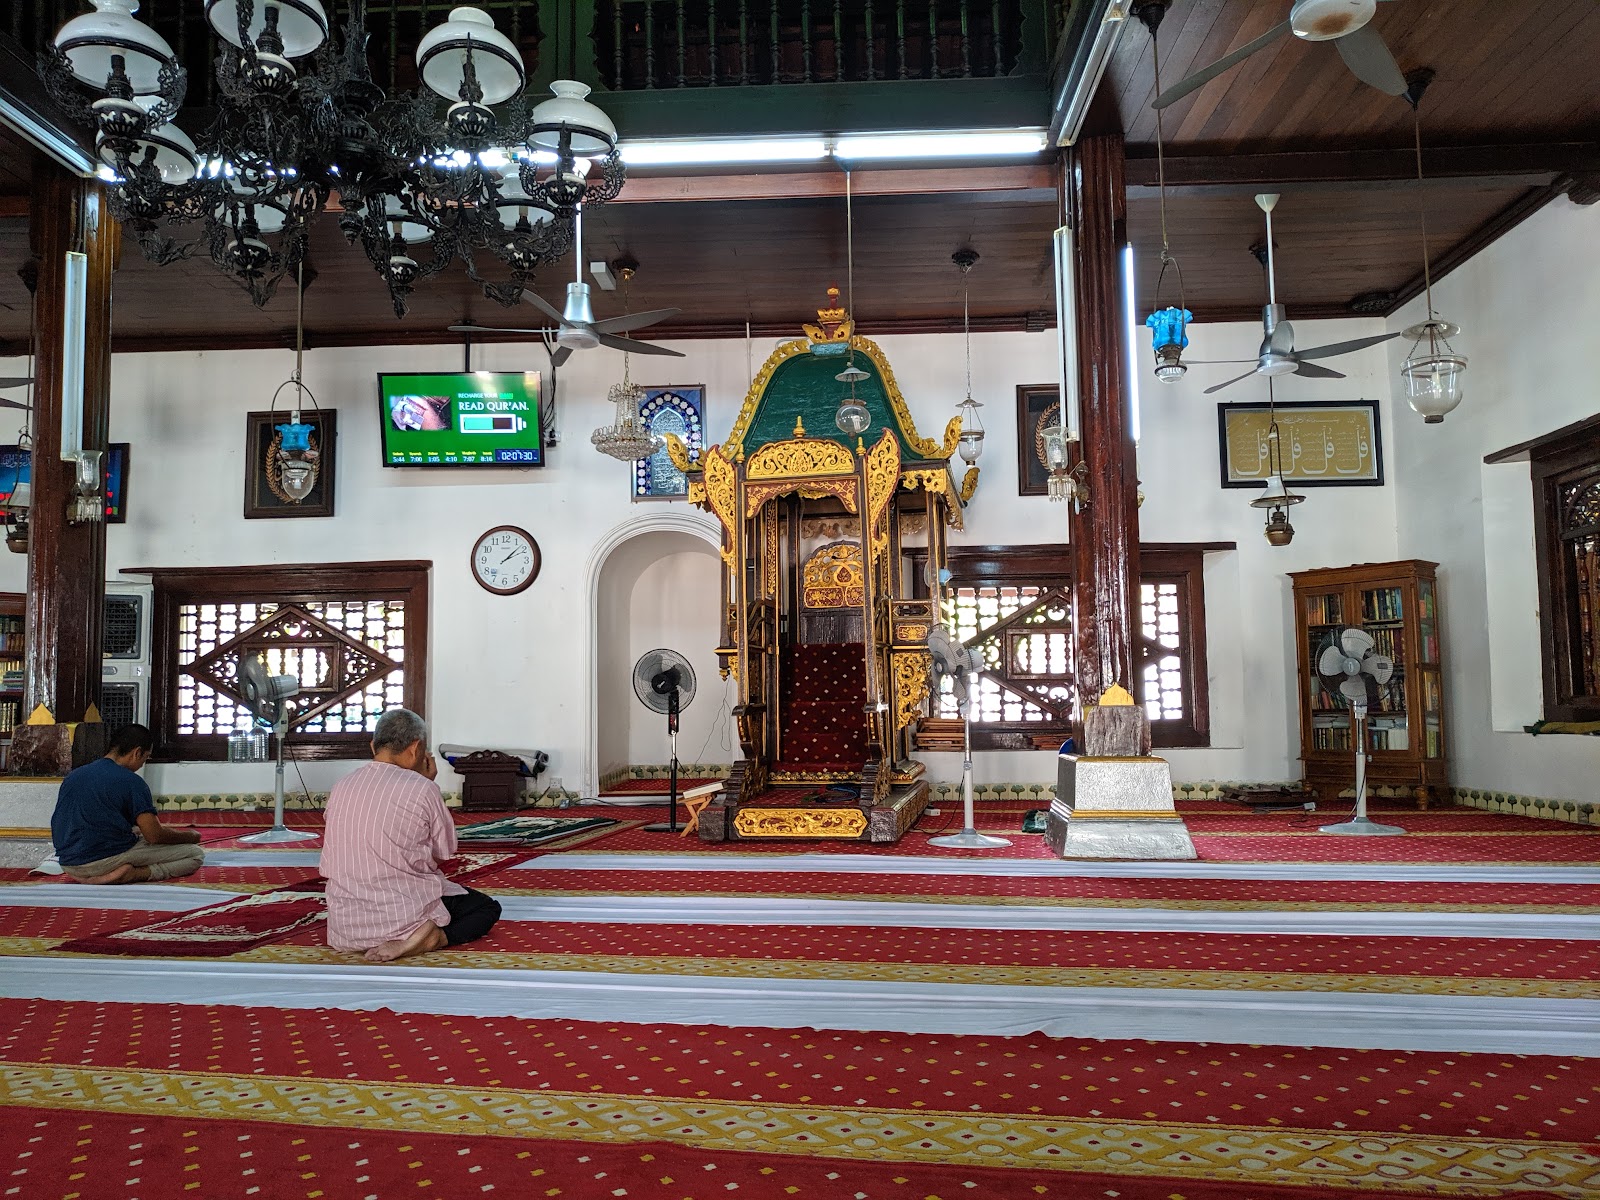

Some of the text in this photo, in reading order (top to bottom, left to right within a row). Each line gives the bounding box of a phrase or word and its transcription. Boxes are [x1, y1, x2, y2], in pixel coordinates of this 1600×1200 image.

[458, 401, 484, 410] READ
[502, 535, 511, 543] 12
[481, 556, 487, 564] 9
[484, 567, 490, 575] 8
[502, 577, 507, 585] 6
